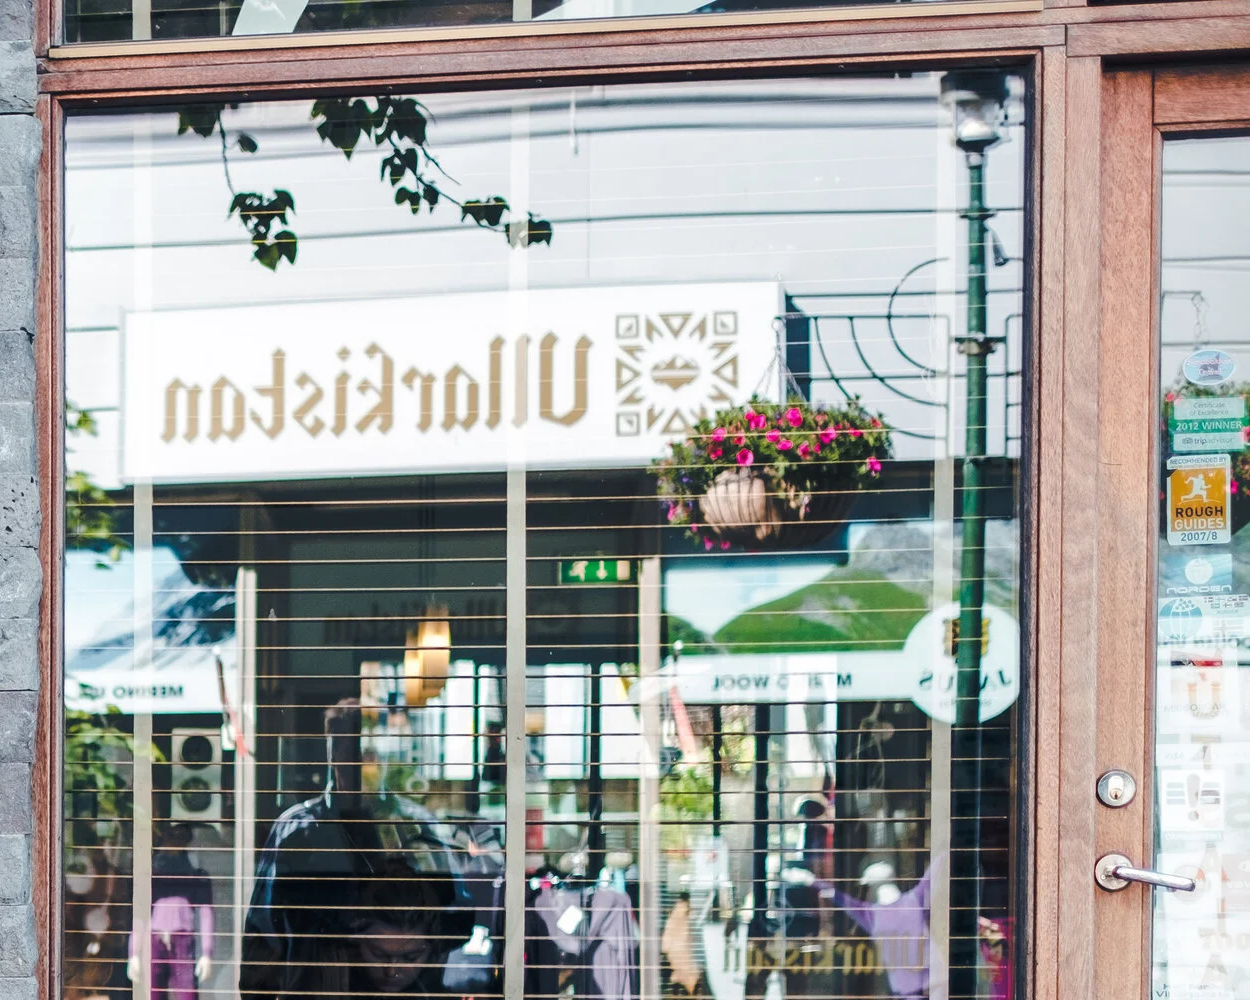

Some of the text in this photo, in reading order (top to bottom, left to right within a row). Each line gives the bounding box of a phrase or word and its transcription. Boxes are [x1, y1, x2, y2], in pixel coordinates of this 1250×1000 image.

[1176, 420, 1242, 431] 2012 WINNER
[1170, 457, 1217, 465] RECOMMENDED
[1175, 506, 1223, 518] ROUGH
[1174, 518, 1225, 530] GUIDES
[1180, 531, 1218, 542] 2007/8
